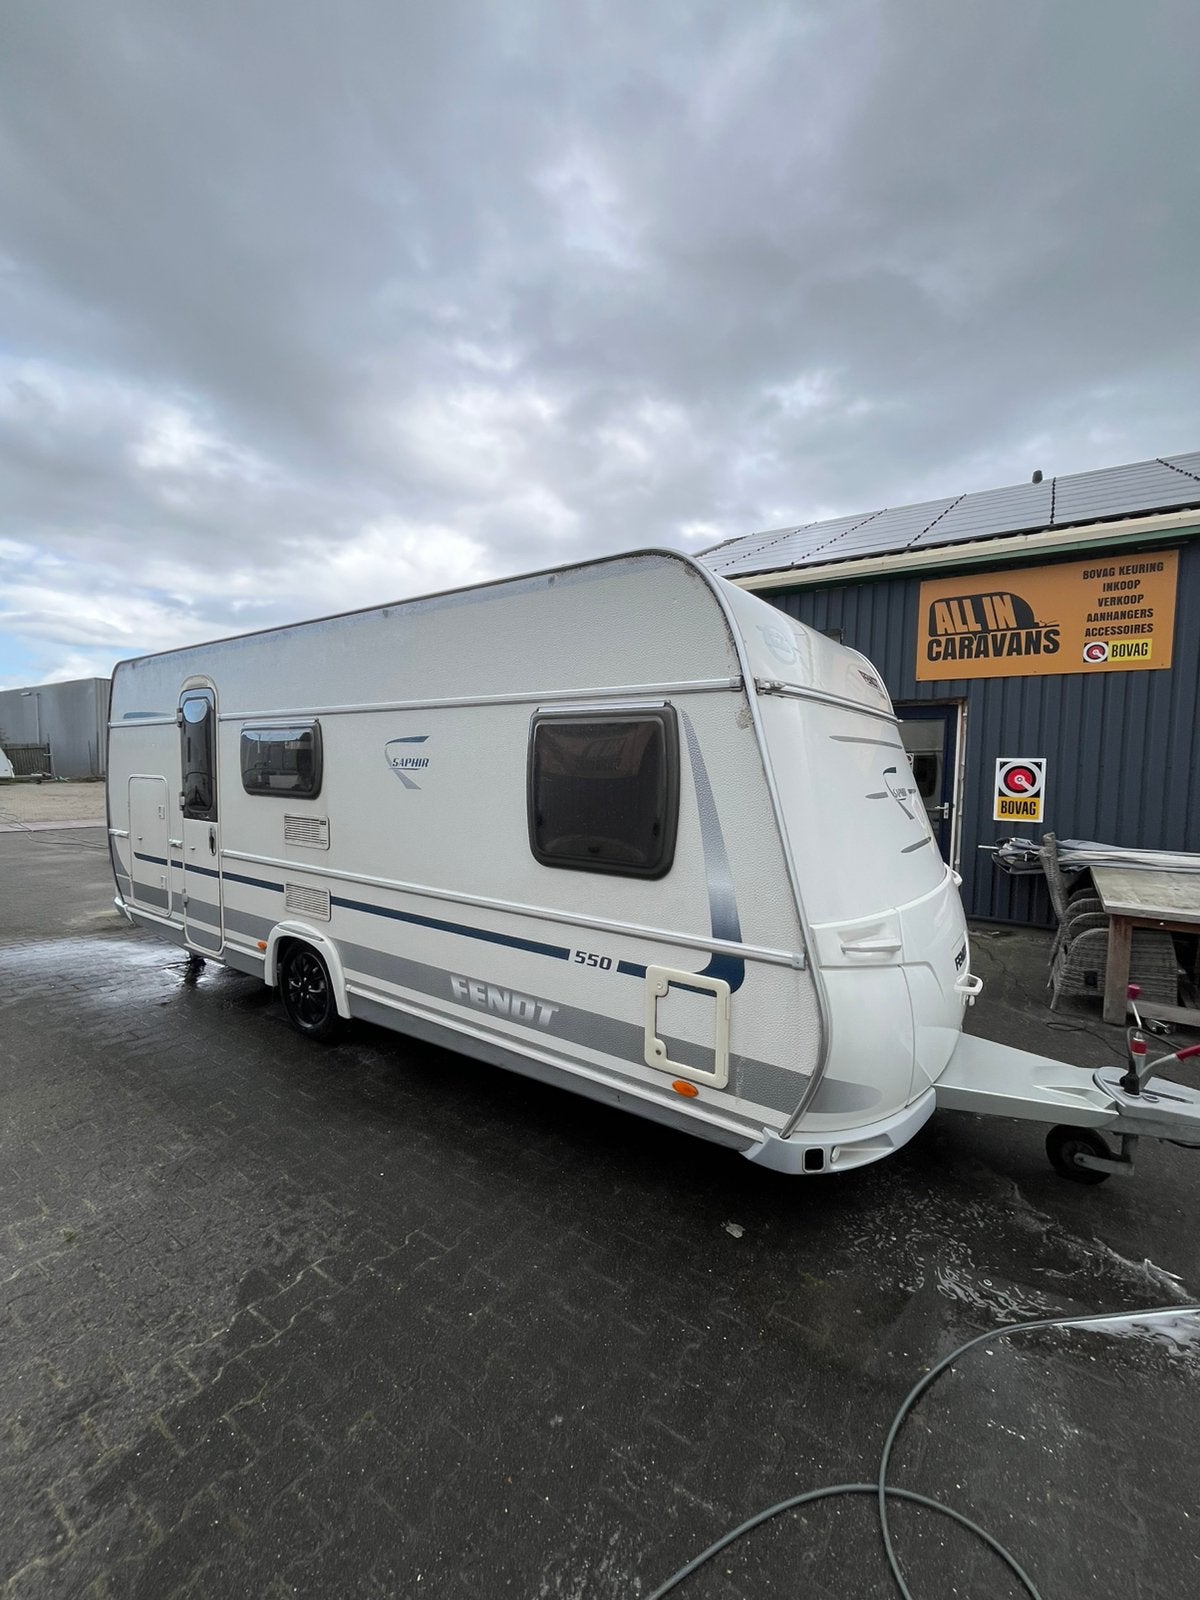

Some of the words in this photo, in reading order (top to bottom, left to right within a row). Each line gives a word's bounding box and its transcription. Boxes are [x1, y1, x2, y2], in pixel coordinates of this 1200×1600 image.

[1082, 567, 1115, 580] BOVAG
[1118, 562, 1164, 576] KEURING
[1102, 579, 1141, 592] INKOOP
[1097, 594, 1144, 608] VERKOOP
[934, 600, 982, 635] ALL
[983, 594, 1018, 630] IN
[1086, 608, 1154, 623] AANHANGERS
[1085, 623, 1154, 638] ACCESSOIRES
[927, 629, 1060, 662] CARAVANS
[1111, 642, 1149, 658] BOVAG
[392, 757, 430, 768] SAPHIR
[1000, 800, 1036, 816] BOVAG
[574, 950, 612, 971] 550
[450, 974, 559, 1027] FENDT
